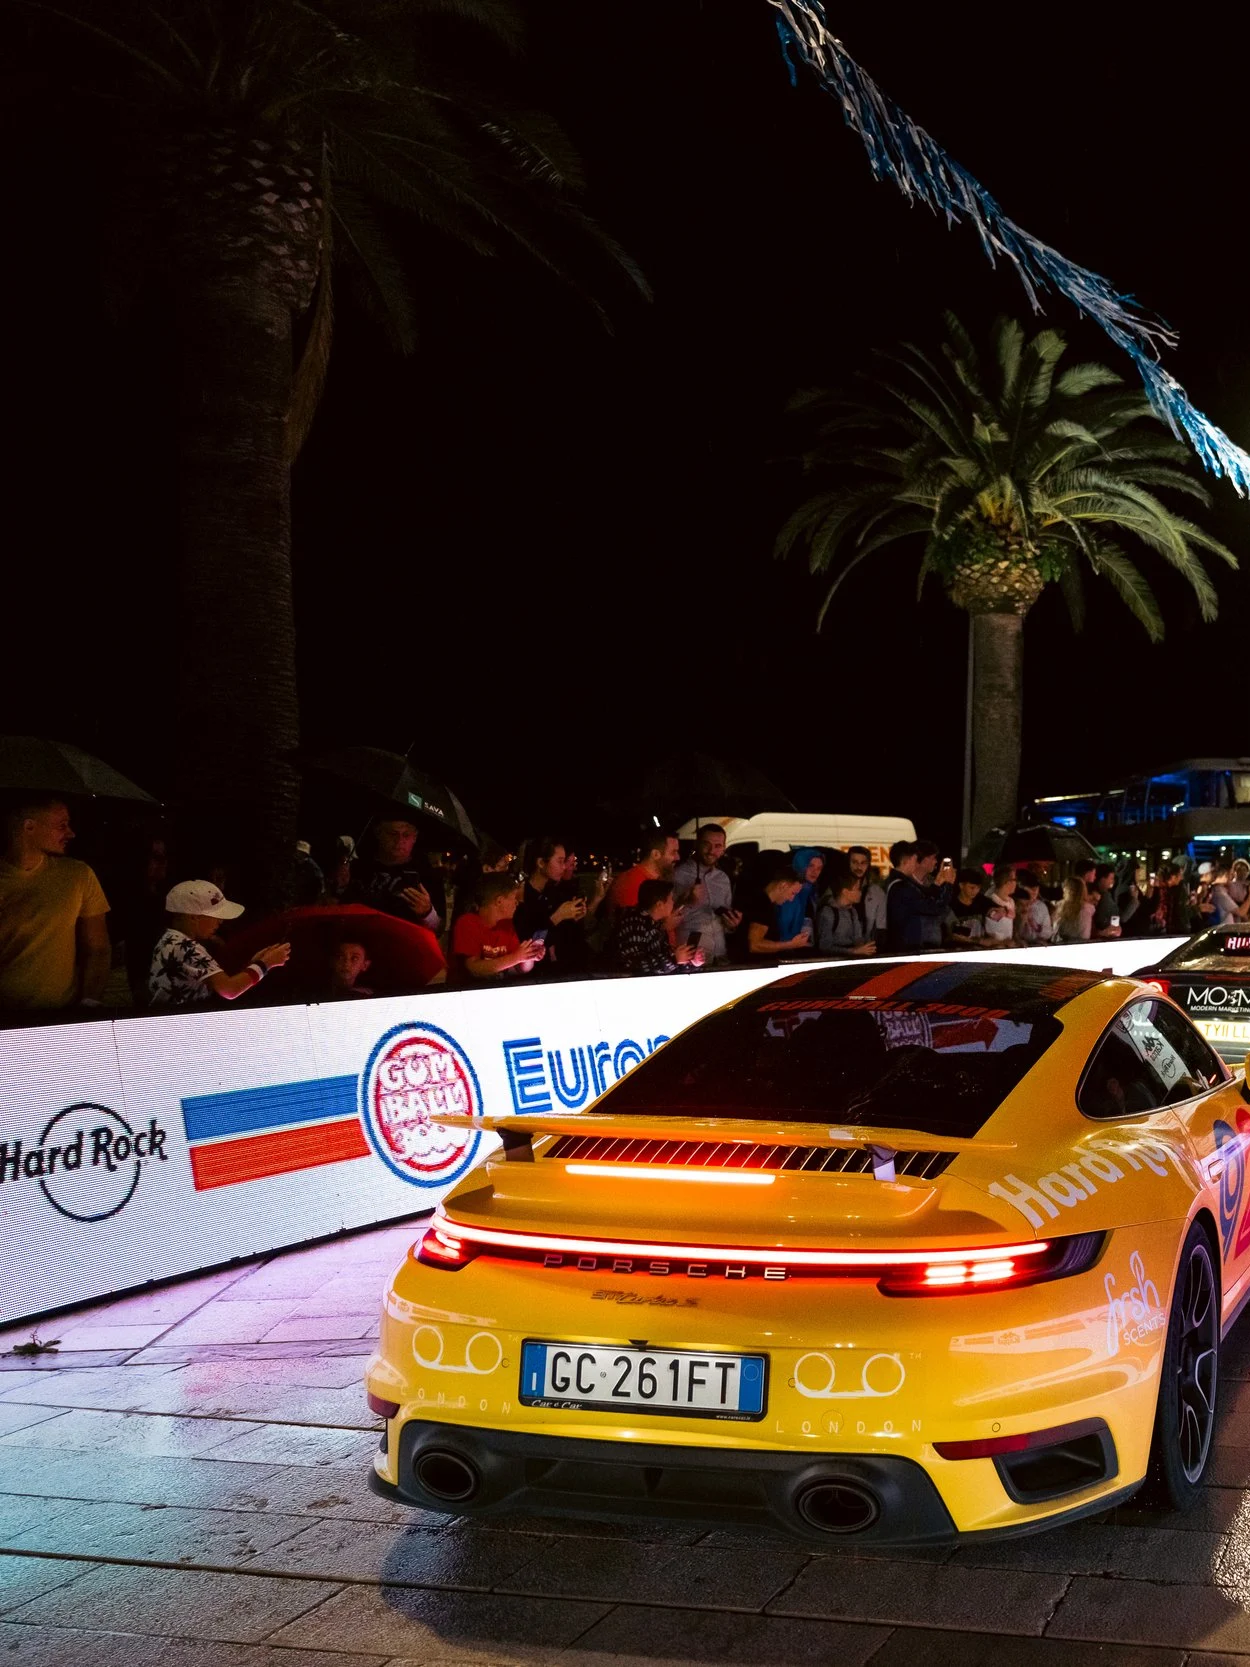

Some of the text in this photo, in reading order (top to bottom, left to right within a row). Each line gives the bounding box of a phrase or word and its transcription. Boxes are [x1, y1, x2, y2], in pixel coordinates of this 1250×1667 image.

[378, 1052, 460, 1091] GUM
[381, 1079, 467, 1125] BALL
[0, 1119, 168, 1184] Hard Rock
[988, 1146, 1125, 1229] Hard
[544, 1254, 786, 1280] PORSCHE
[1104, 1250, 1160, 1356] frsh
[1123, 1313, 1166, 1345] SCENTS
[551, 1351, 597, 1394] GC
[612, 1355, 735, 1404] 261FT
[531, 1399, 552, 1407] Car
[561, 1401, 582, 1409] Car
[776, 1420, 921, 1433] LONDON
